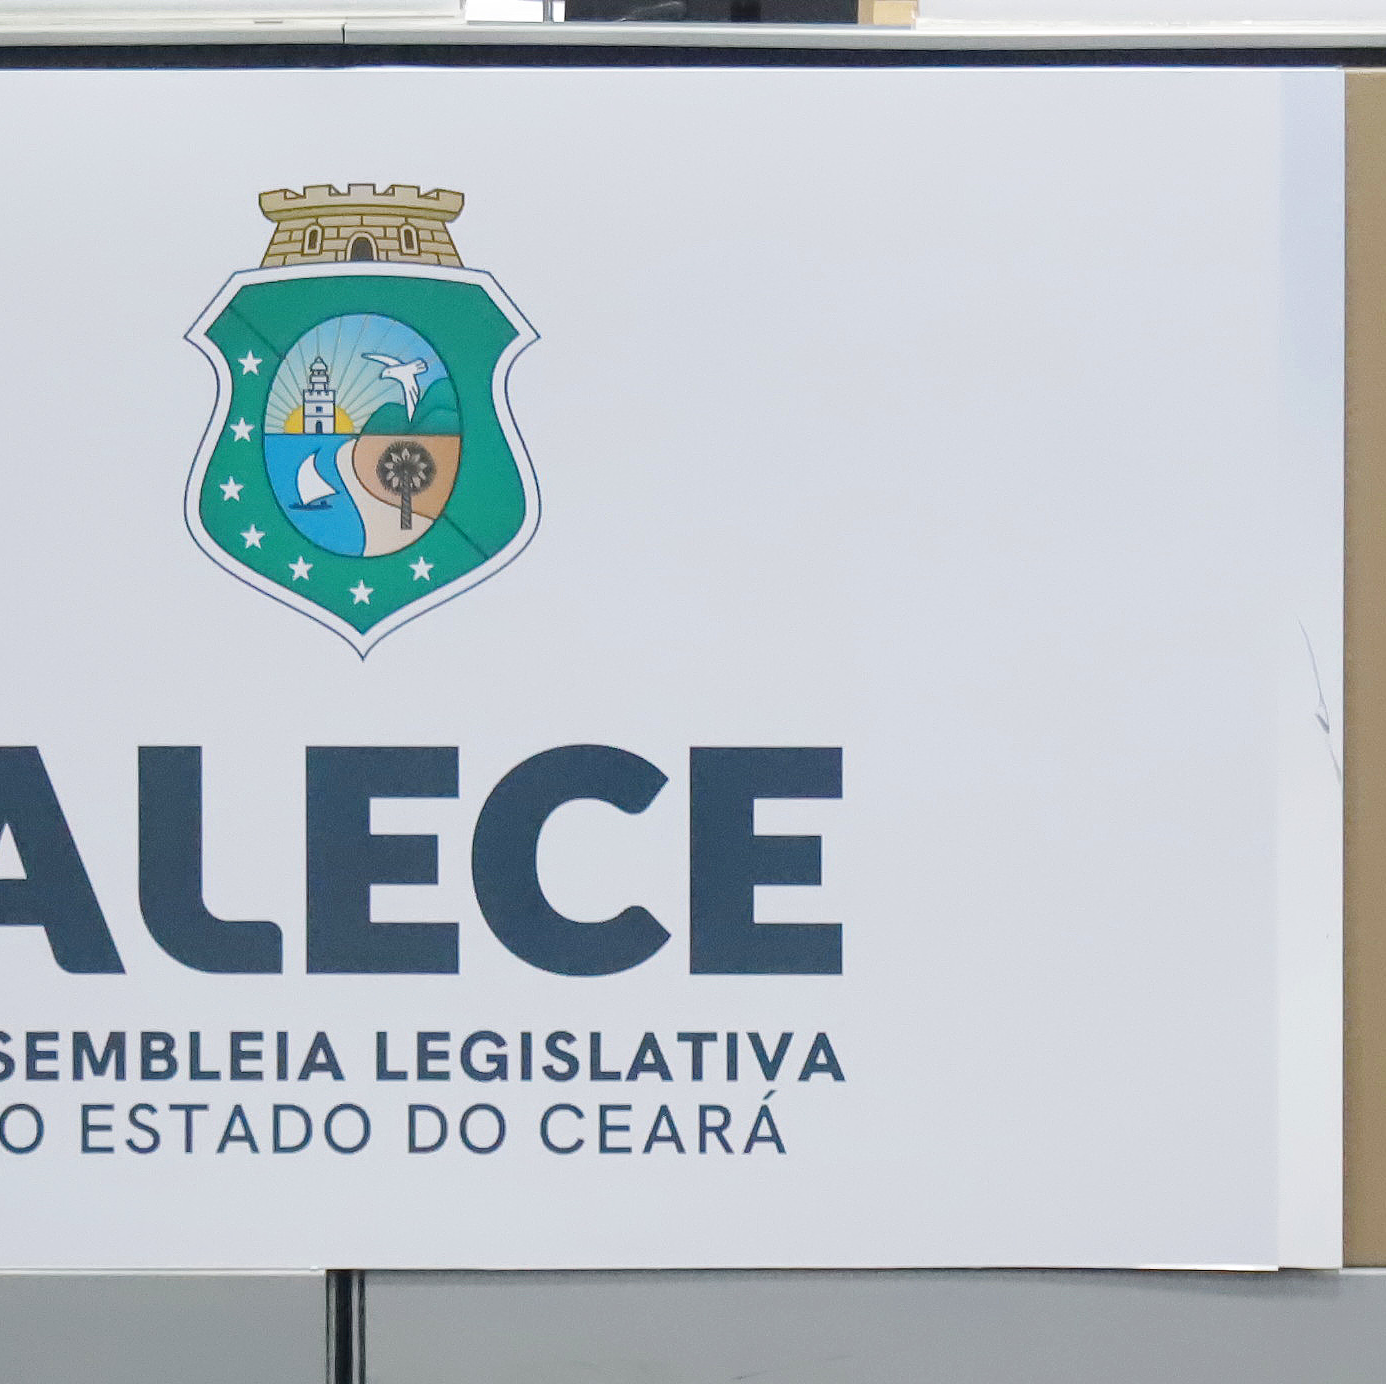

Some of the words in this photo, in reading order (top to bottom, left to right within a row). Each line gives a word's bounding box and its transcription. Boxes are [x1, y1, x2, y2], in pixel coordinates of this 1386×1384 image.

[375, 1030, 846, 1084] LEGISLATIVA
[80, 1102, 372, 1155] ESTADO
[407, 1102, 507, 1155] DO
[539, 1089, 787, 1155] CEARÁ
